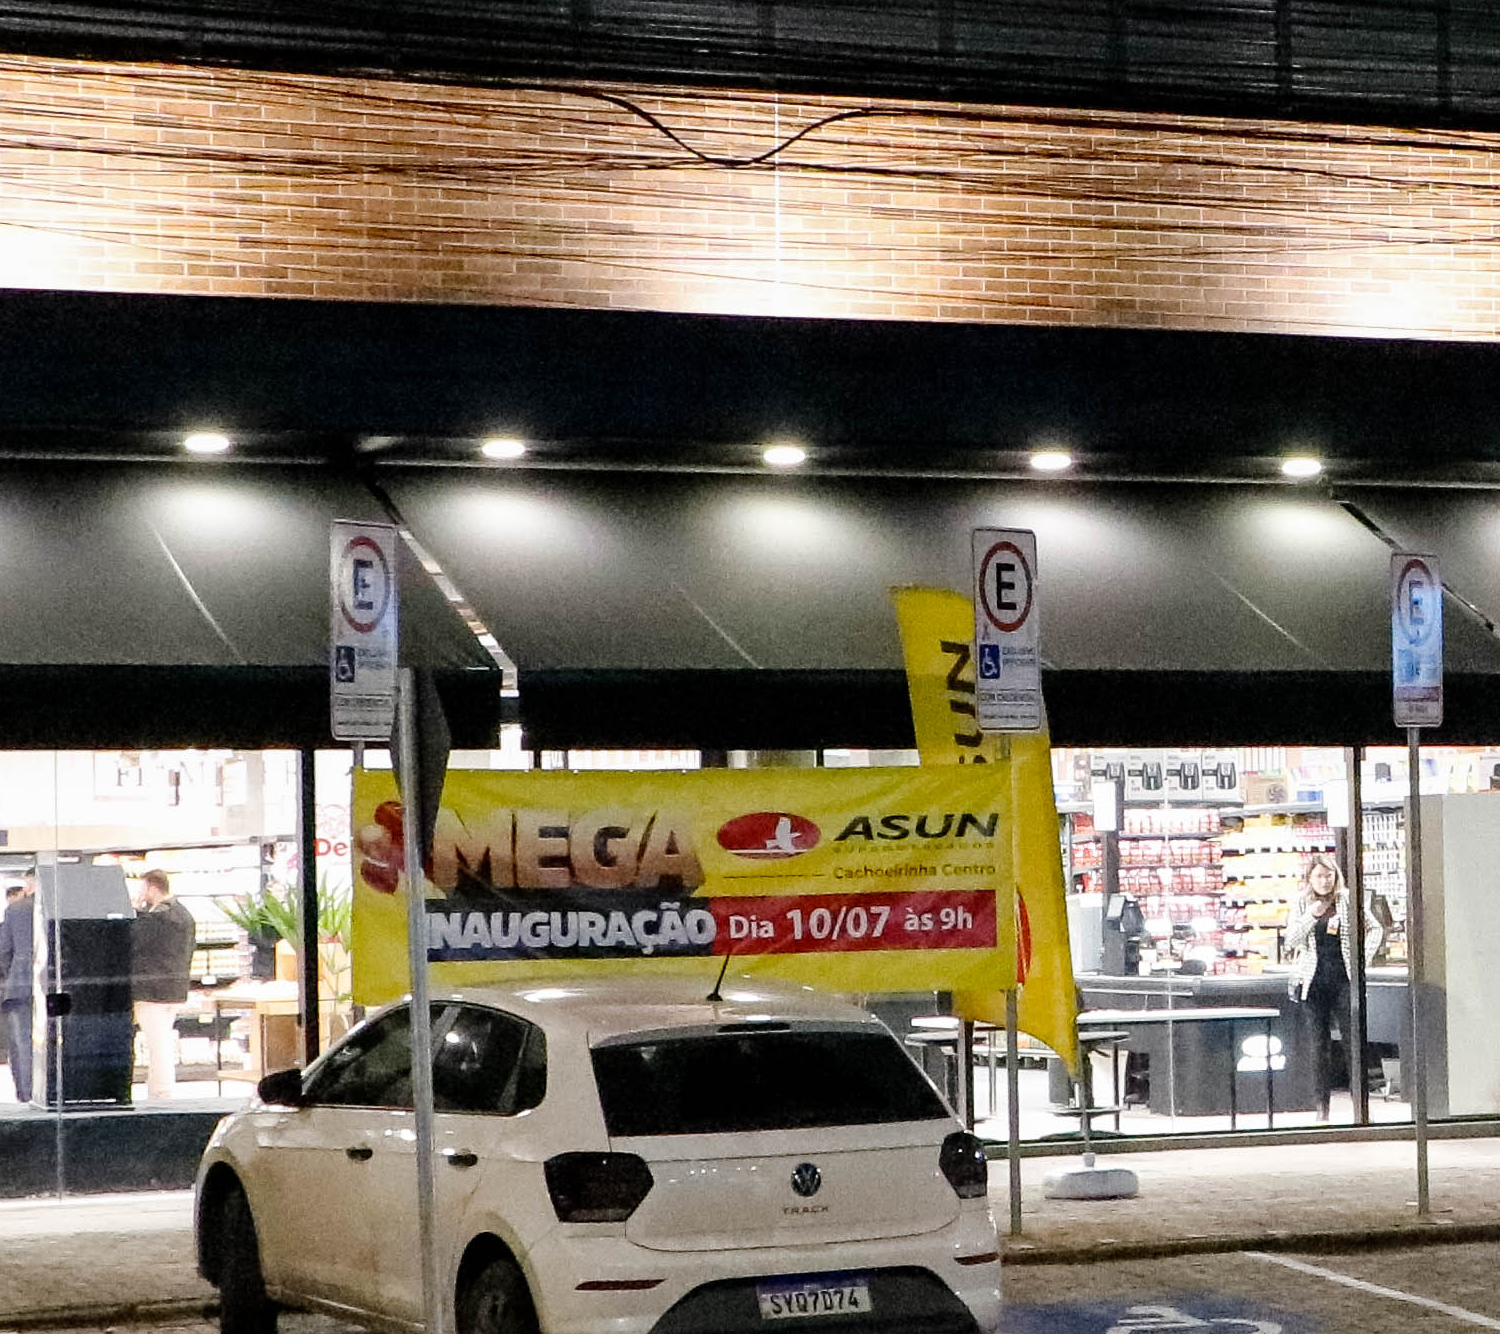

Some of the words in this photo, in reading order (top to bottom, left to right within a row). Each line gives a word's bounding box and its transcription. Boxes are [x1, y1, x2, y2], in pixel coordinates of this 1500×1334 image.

[354, 559, 373, 610] E
[996, 563, 1016, 610] E
[430, 810, 705, 890] MEGA
[834, 812, 999, 841] ASUN
[834, 863, 936, 879] Cachoeirinha
[941, 863, 996, 876] Centro
[424, 900, 717, 956] INAUGURAÇÃO
[729, 915, 774, 939] Dia
[787, 906, 891, 940] 10/07
[904, 907, 933, 931] às
[939, 906, 973, 930] 9h
[782, 1205, 829, 1215] TRACK
